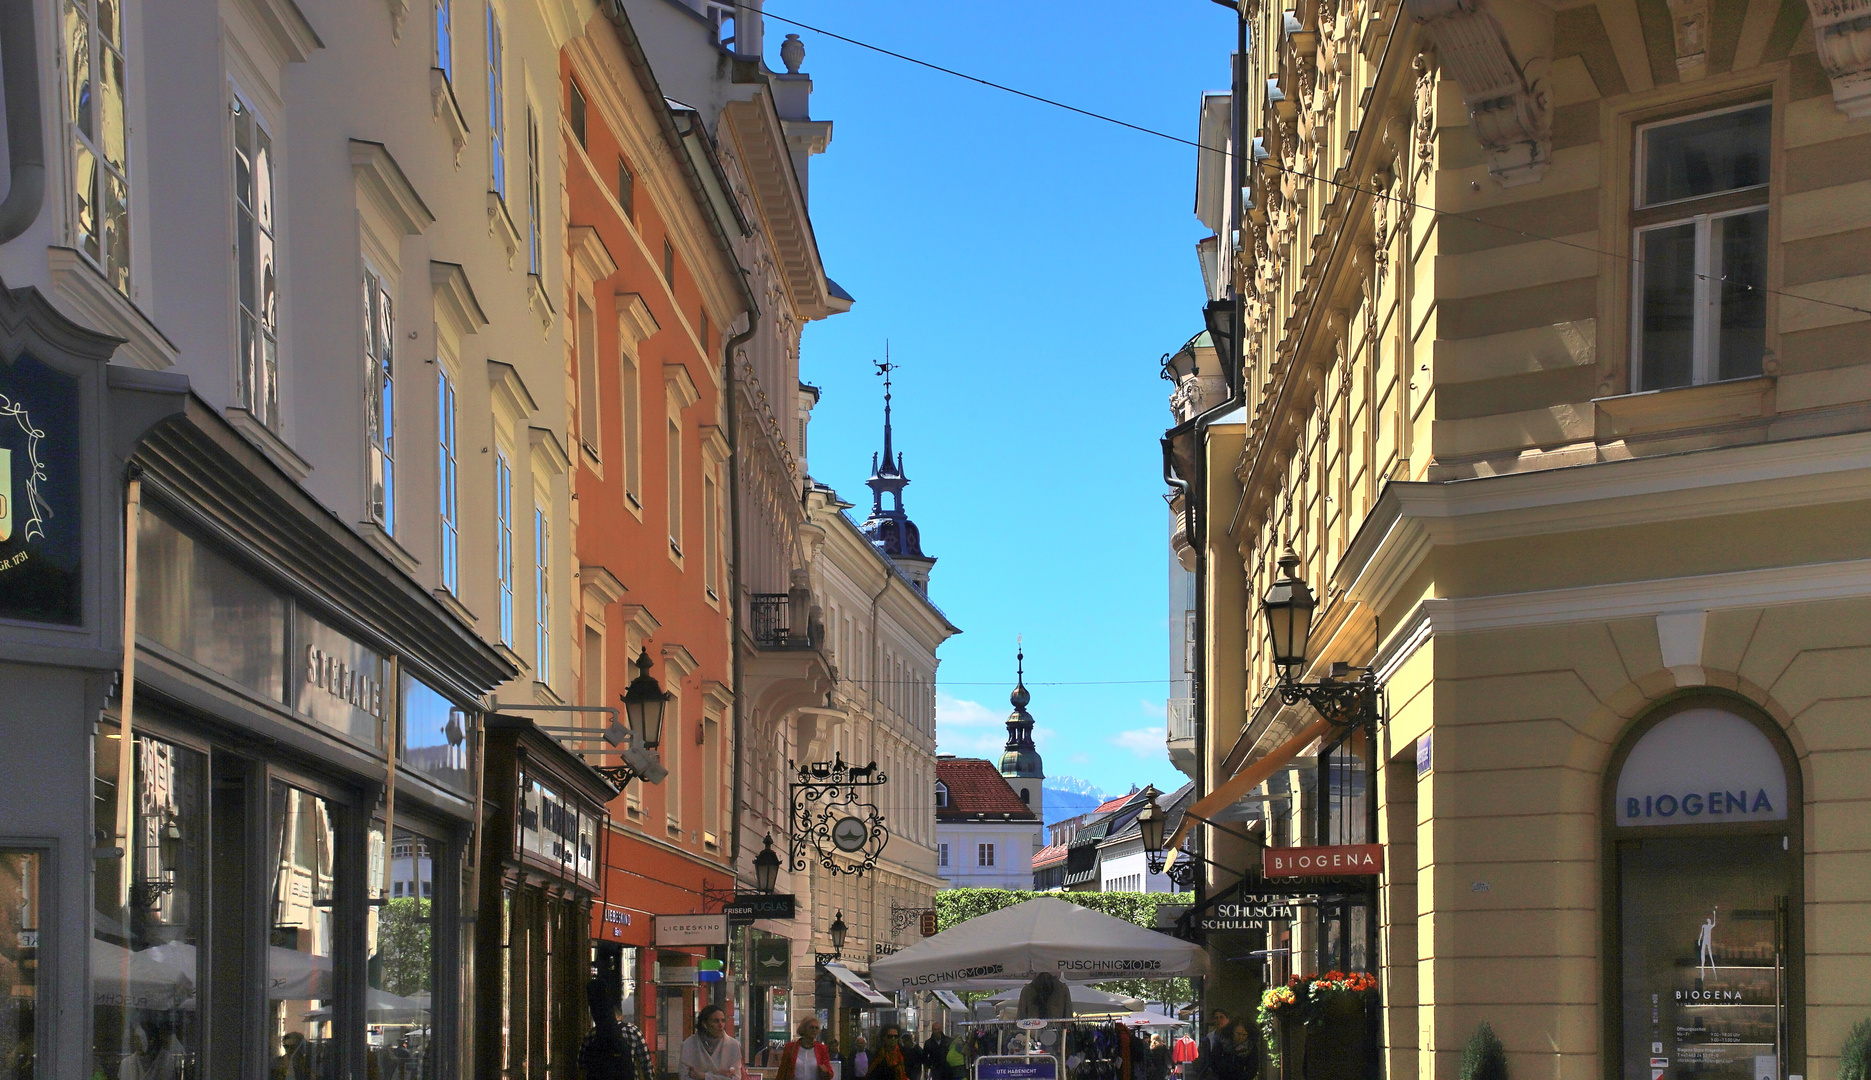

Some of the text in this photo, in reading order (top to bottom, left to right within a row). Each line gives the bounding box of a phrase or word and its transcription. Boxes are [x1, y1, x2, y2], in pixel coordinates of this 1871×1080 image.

[12, 550, 29, 566] 1731
[1627, 788, 1773, 818] BIOGENA
[1275, 853, 1374, 869] BIOGENA
[724, 907, 753, 915] FRISEUR
[1218, 904, 1292, 918] SCHUSCHA
[663, 924, 720, 932] LIEBESKIND
[922, 915, 936, 934] B
[1201, 920, 1263, 930] SCHULLIN
[1675, 990, 1742, 1000] BIOGENA
